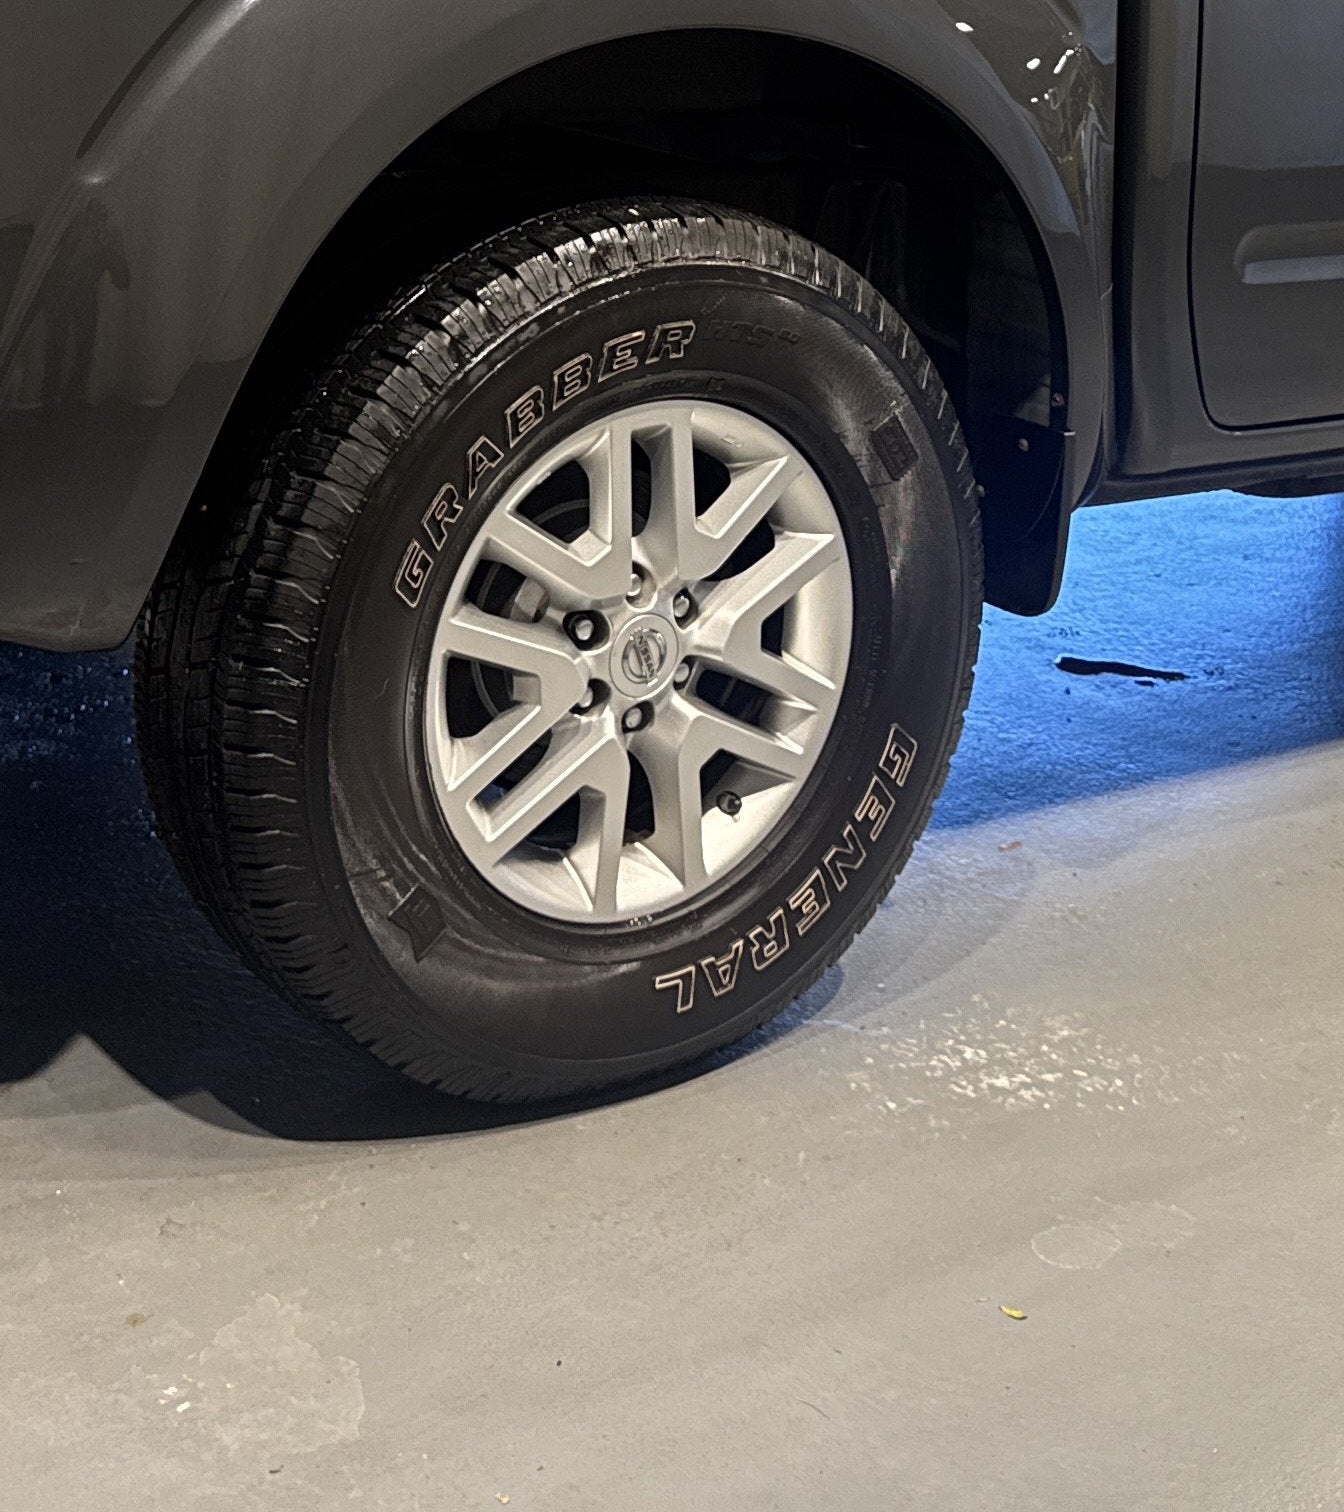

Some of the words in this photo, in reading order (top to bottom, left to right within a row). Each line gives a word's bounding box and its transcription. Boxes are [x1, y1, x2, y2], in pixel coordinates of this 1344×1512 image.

[393, 318, 697, 609] GRABBER
[636, 634, 656, 679] NISSAN
[654, 722, 919, 1015] GENERAL
